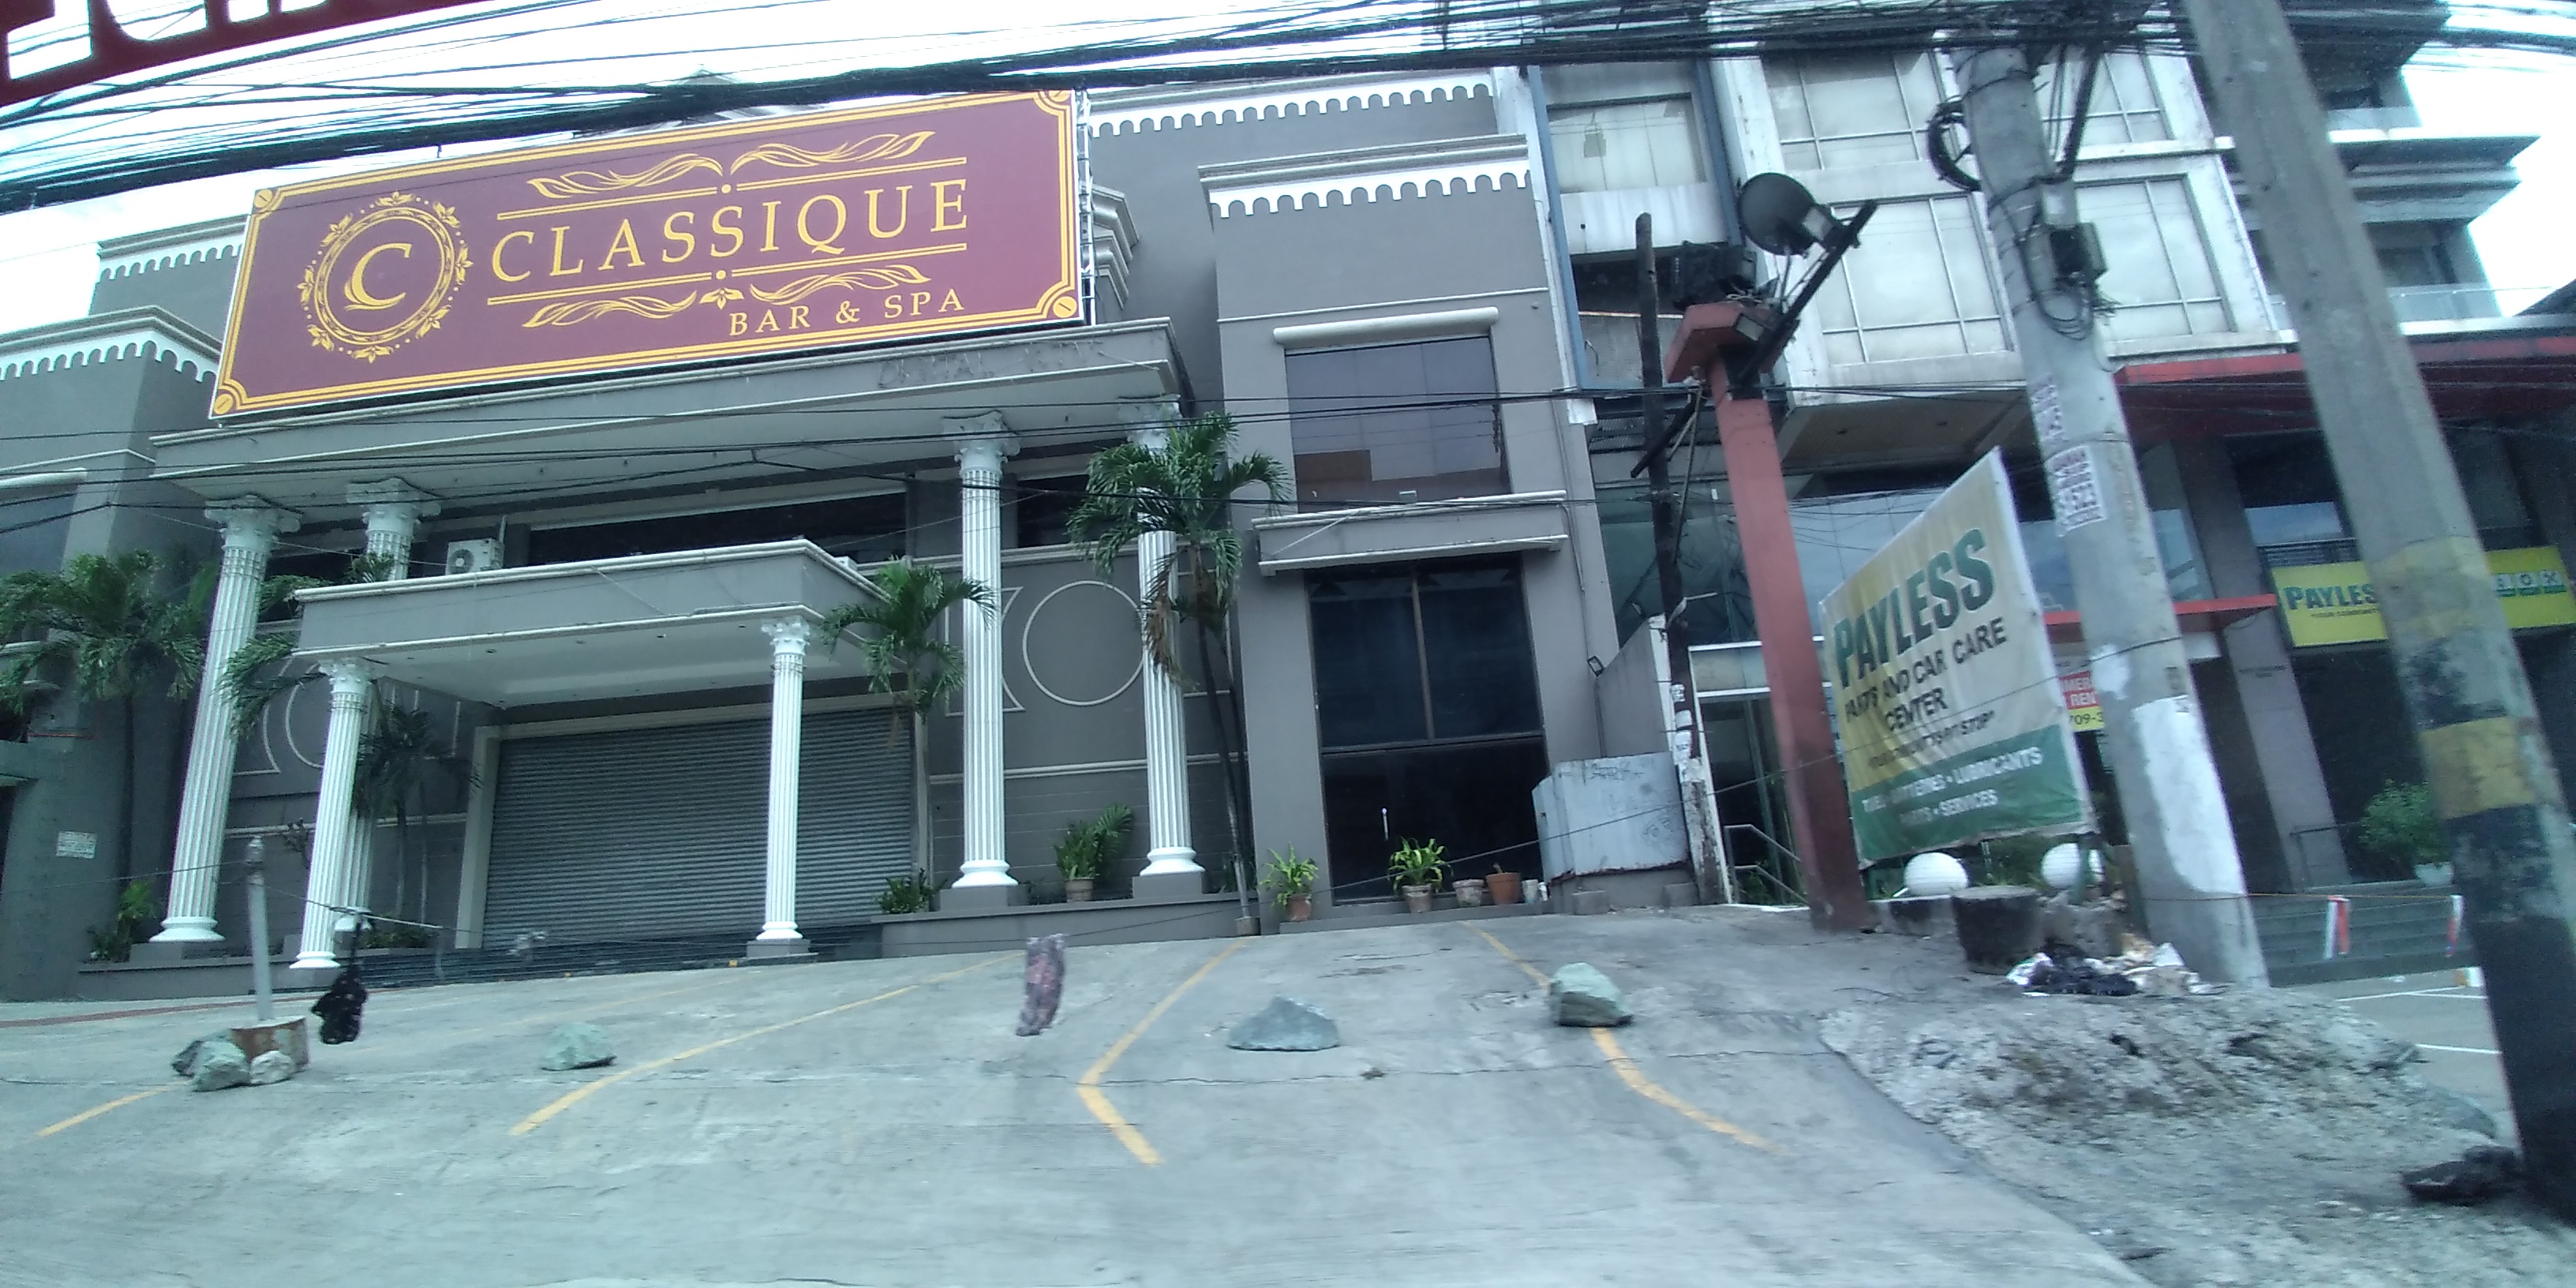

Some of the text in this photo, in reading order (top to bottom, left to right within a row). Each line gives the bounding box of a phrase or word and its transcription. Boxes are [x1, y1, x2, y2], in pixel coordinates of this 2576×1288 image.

[492, 178, 968, 283] CLASSIQUE
[344, 242, 412, 311] C
[729, 288, 964, 336] BAR & SPA
[1833, 528, 1995, 689] PAYLESS
[1913, 650, 1947, 684] CAR
[1953, 616, 2008, 665] CARE
[1885, 687, 1948, 732] CENTER
[1939, 788, 1998, 816] SERVICES
